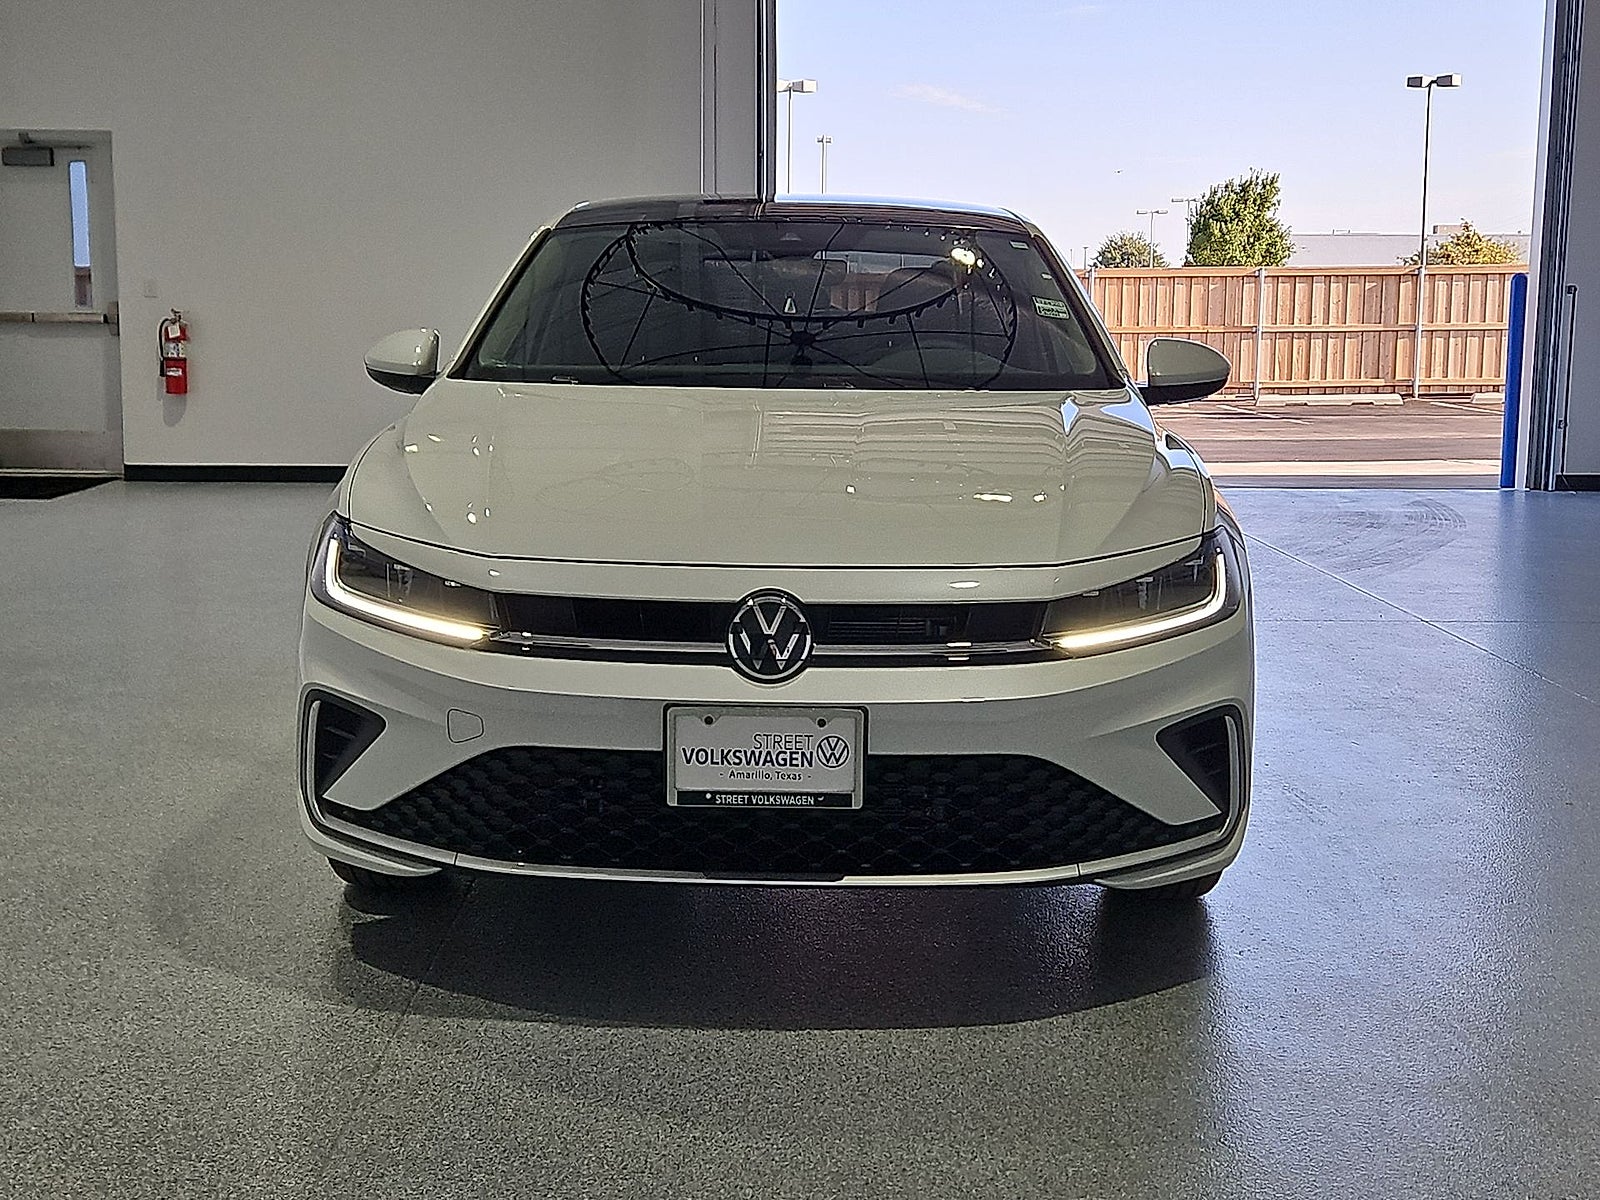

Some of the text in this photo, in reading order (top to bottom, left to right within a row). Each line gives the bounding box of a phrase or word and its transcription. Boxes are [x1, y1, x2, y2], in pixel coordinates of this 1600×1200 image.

[753, 733, 814, 751] STREET
[681, 747, 814, 768] VOLKSWAGEN
[818, 736, 849, 767] VW
[728, 769, 802, 781] Amarillo, Texas
[715, 794, 815, 806] STREET VOLKSWAGEN
